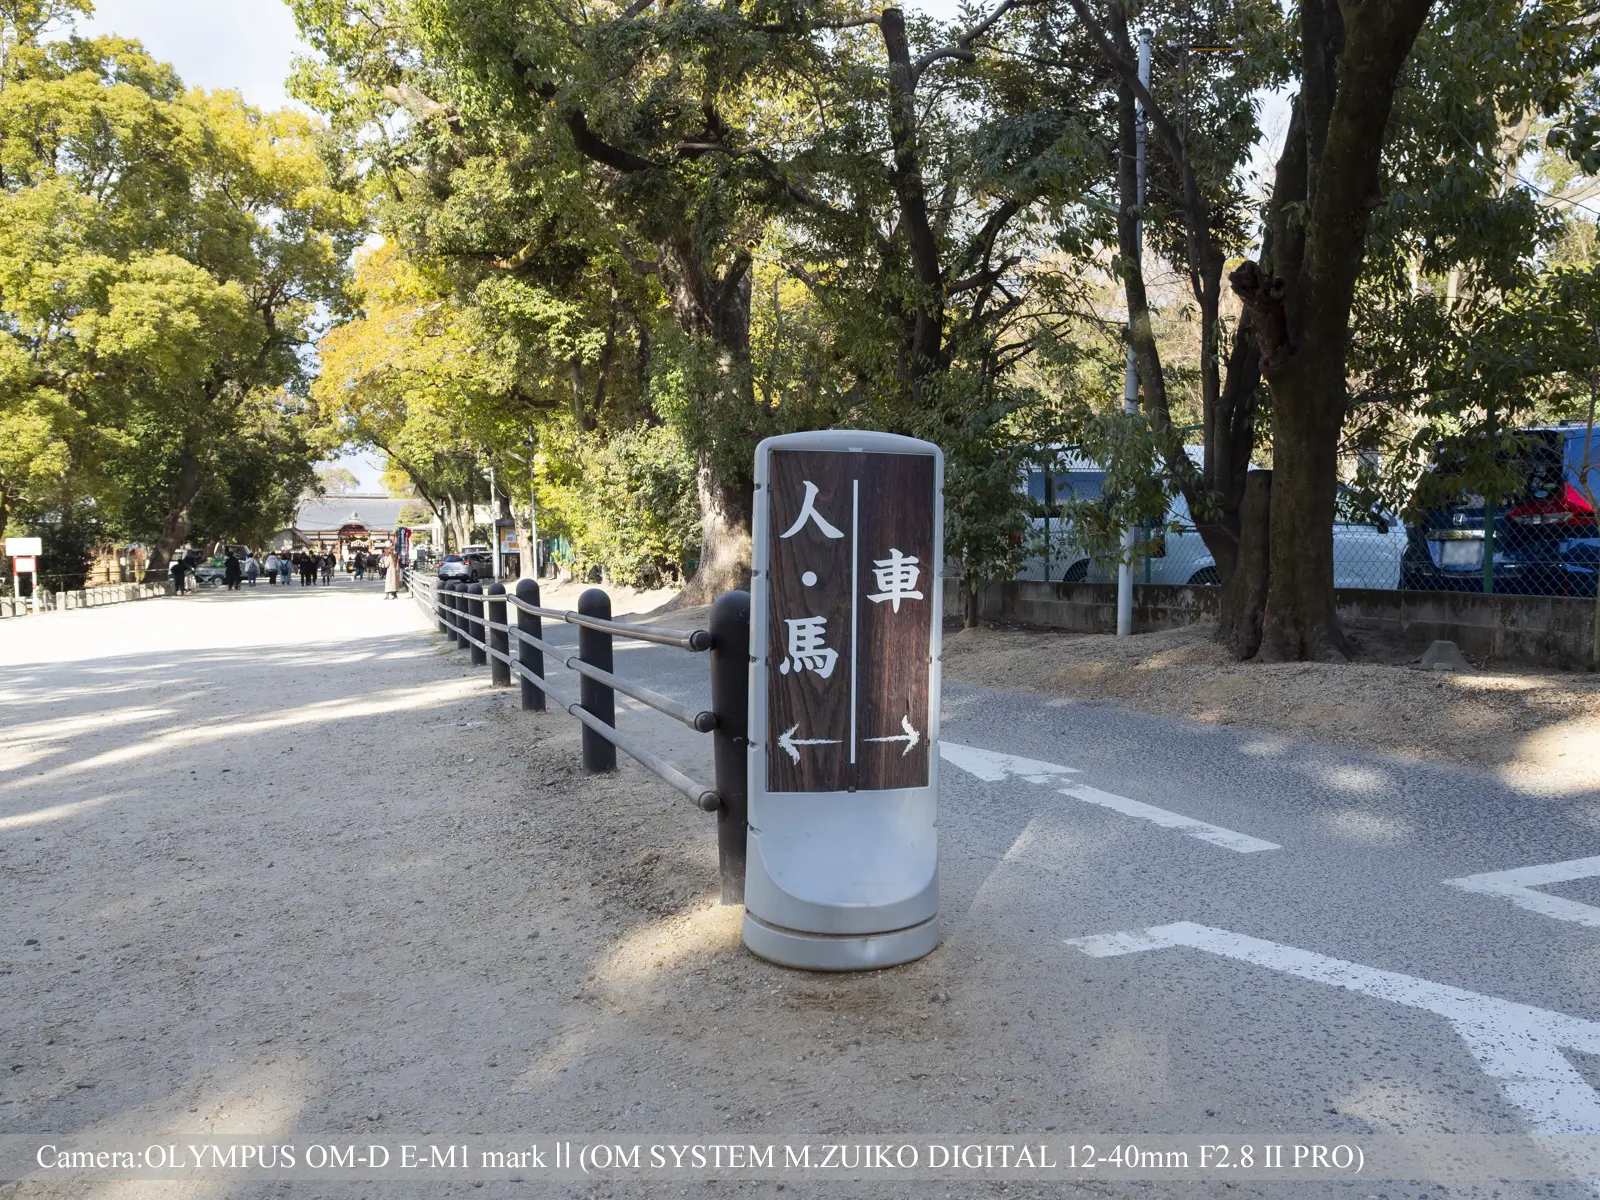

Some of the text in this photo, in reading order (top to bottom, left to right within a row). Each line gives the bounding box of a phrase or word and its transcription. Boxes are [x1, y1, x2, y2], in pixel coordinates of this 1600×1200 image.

[779, 480, 845, 679] 人・馬
[866, 547, 924, 614] 車
